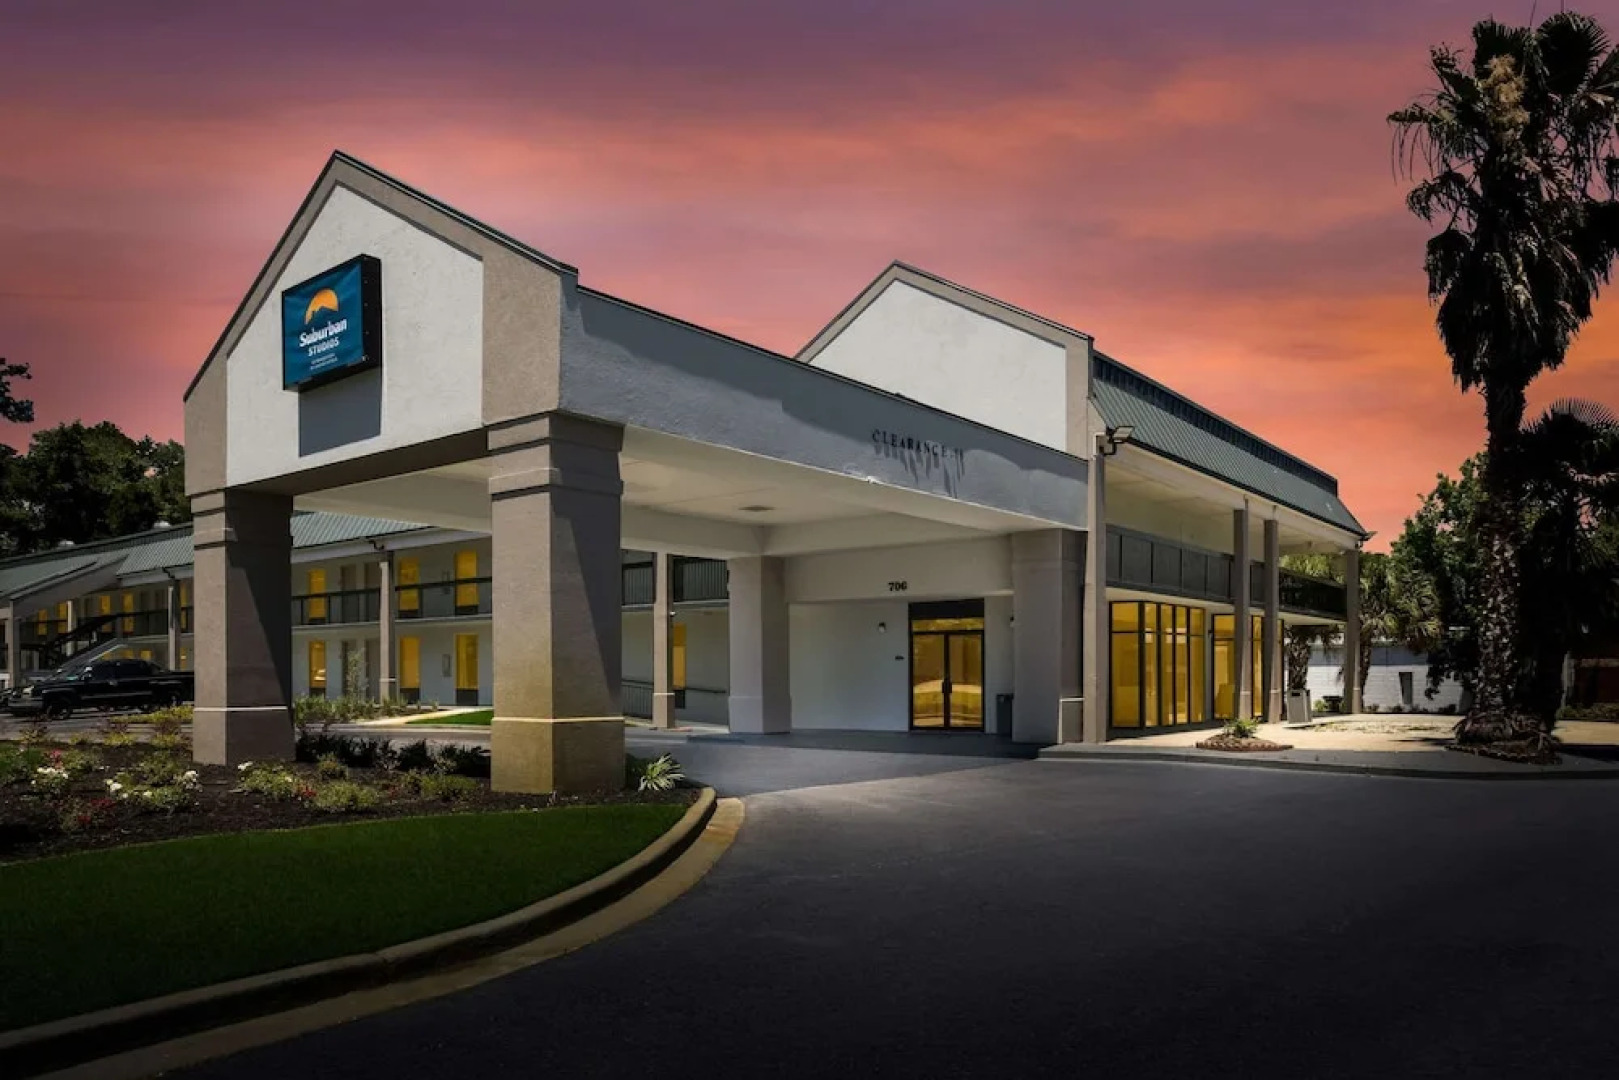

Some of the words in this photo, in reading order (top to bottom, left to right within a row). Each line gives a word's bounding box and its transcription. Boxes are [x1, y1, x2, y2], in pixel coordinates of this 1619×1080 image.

[299, 319, 347, 347] Suburban
[308, 337, 339, 356] STUDIOS
[872, 429, 948, 457] CLEARANCE
[888, 581, 907, 592] 706
